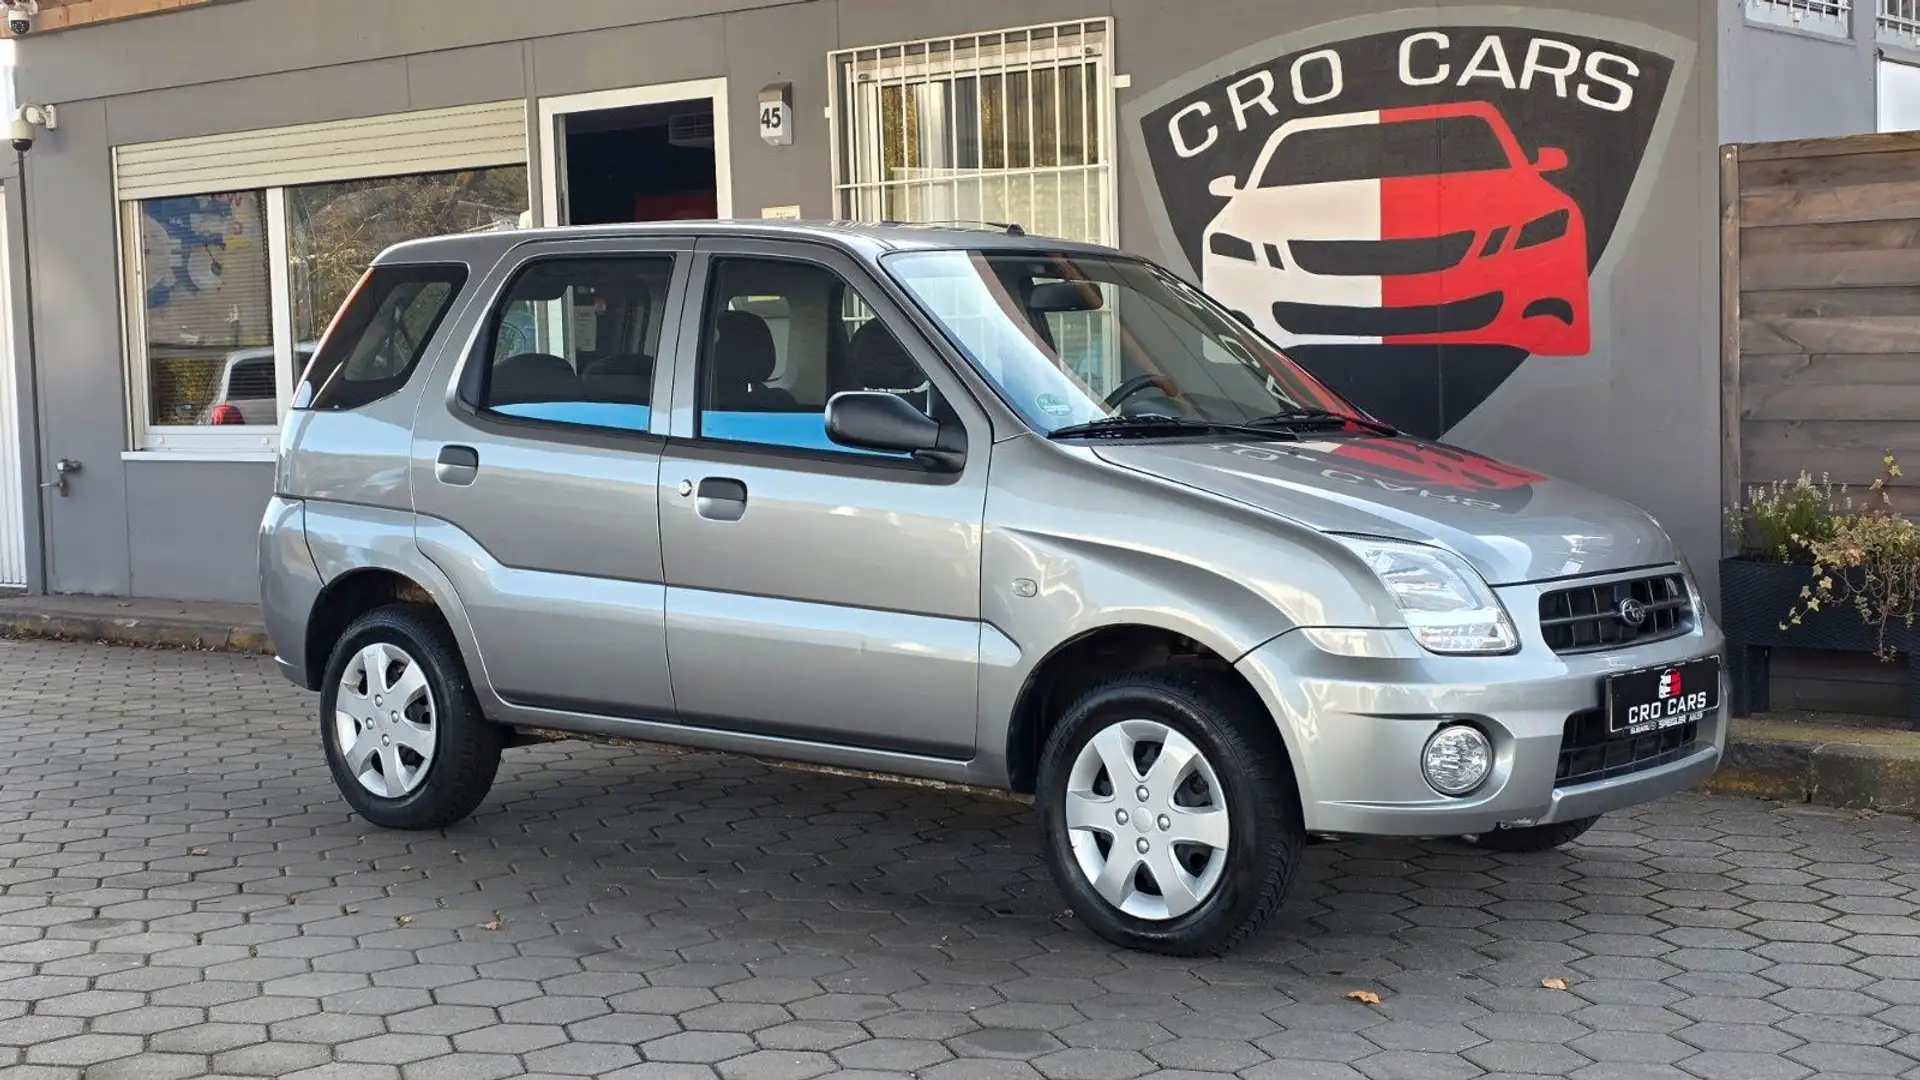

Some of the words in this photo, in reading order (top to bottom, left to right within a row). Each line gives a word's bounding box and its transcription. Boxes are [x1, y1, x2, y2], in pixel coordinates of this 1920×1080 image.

[1168, 49, 1343, 158] CRO
[1398, 32, 1640, 112] CARS
[761, 107, 781, 129] 45
[1628, 702, 1661, 724] CRO
[1667, 691, 1706, 715] CARS
